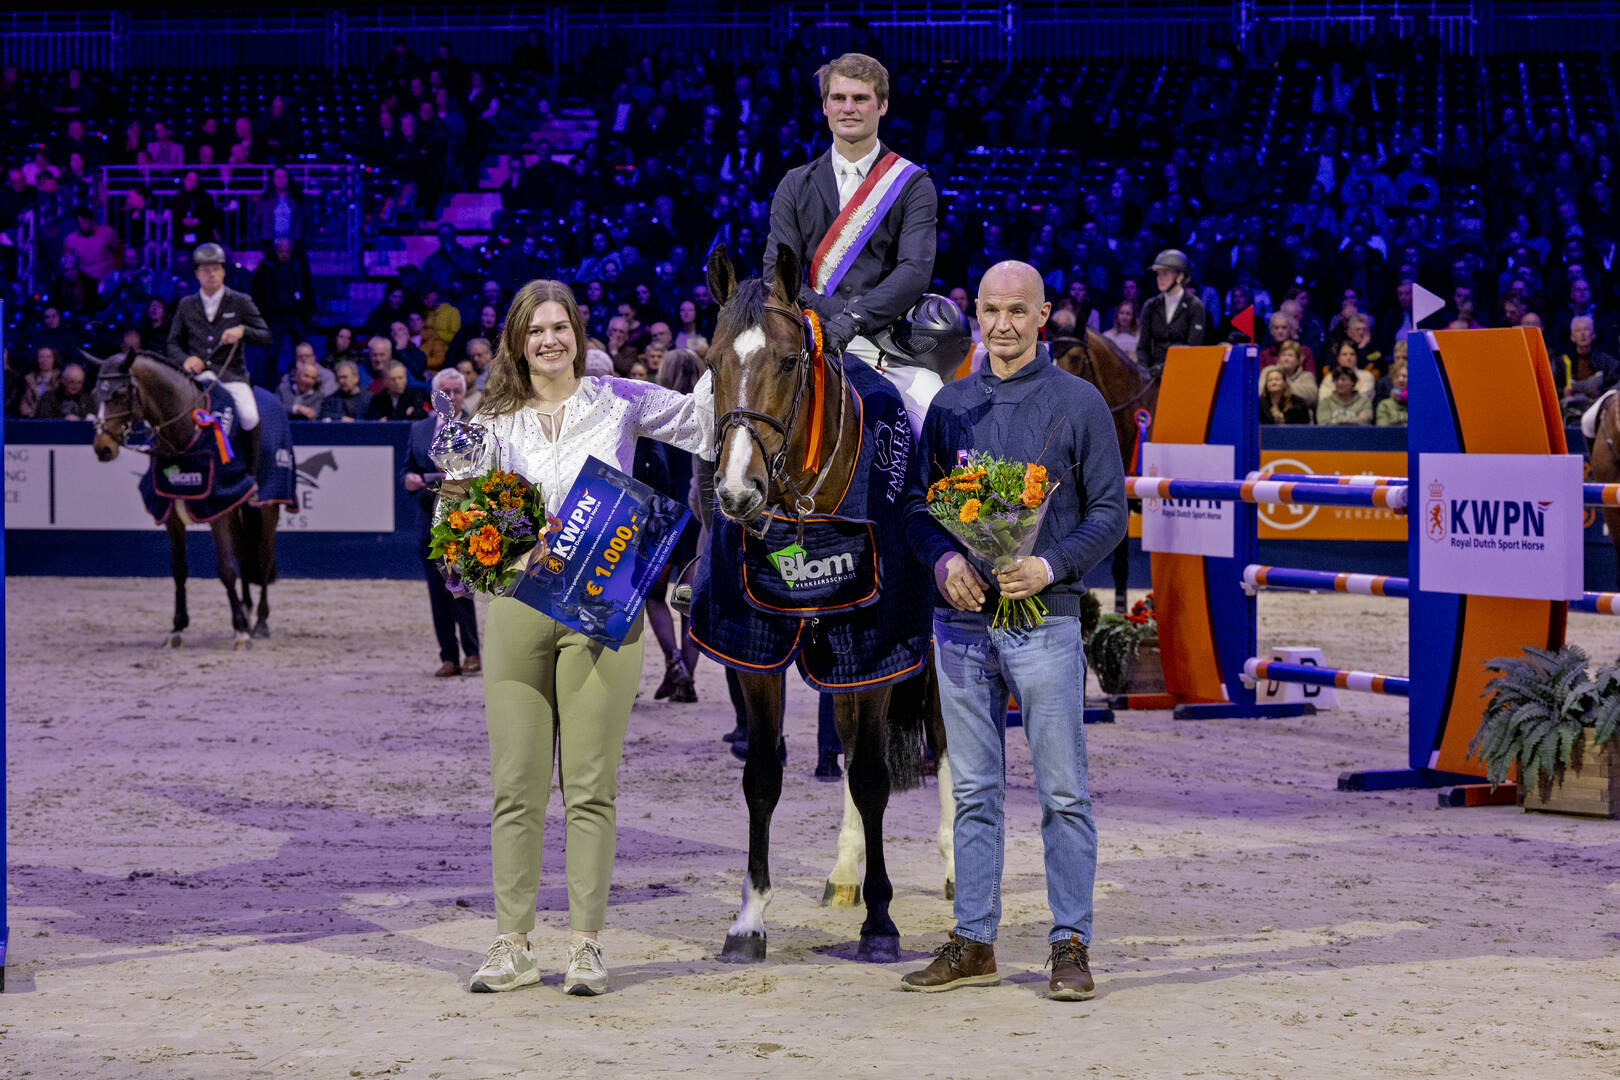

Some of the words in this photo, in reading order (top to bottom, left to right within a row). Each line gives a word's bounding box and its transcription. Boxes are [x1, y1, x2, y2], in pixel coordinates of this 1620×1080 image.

[887, 408, 907, 503] EMMERS
[552, 492, 596, 558] KWPN
[1451, 499, 1545, 537] KWPN
[567, 545, 577, 560] Royal
[586, 580, 603, 596] €
[595, 515, 639, 578] 1.000,-
[1451, 537, 1471, 550] Royal
[1474, 538, 1496, 549] Dutch
[1498, 540, 1519, 551] Sport
[1522, 540, 1544, 551] Horse
[777, 552, 854, 580] Blom
[796, 573, 856, 588] VERKEERSSCHOOL
